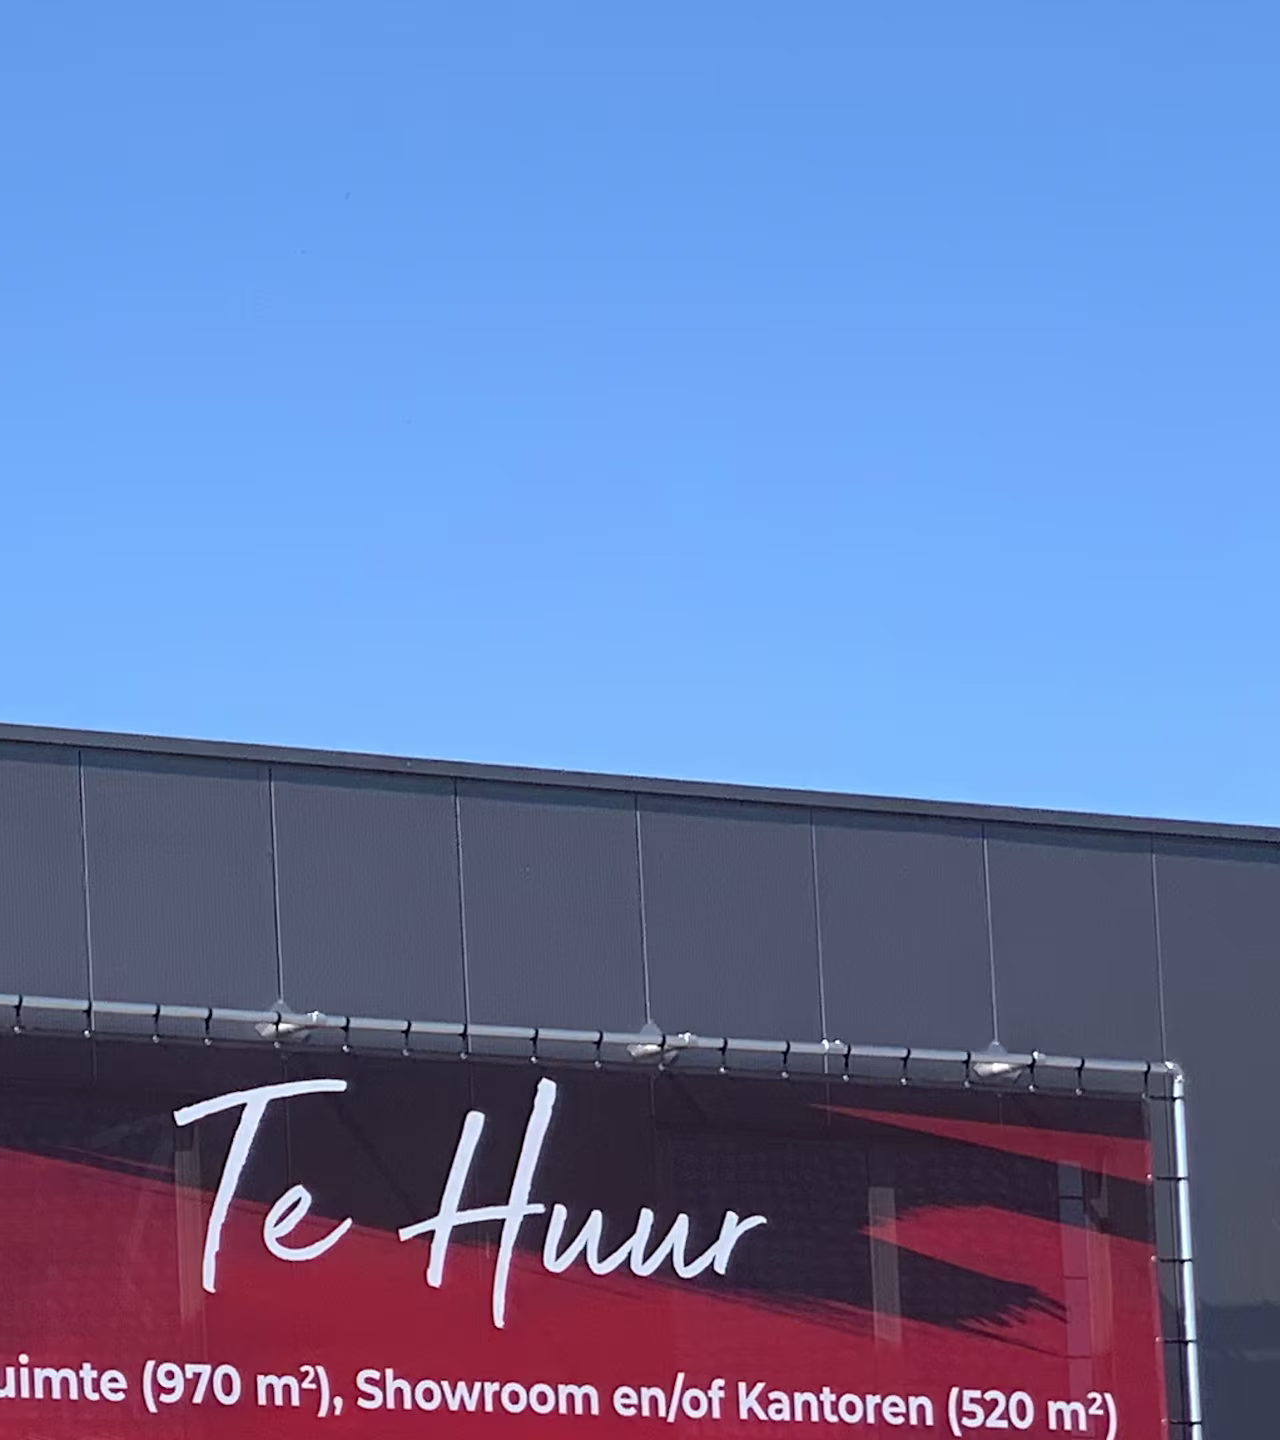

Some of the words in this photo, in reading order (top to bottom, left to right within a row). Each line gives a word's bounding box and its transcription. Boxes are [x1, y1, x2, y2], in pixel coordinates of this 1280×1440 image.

[173, 1079, 352, 1293] Te
[398, 1077, 768, 1329] Huur
[142, 1359, 242, 1413] (970
[355, 1367, 600, 1416] Showroom
[612, 1371, 726, 1424] en/of
[738, 1381, 934, 1427] Kantoren
[947, 1386, 1035, 1437] (520
